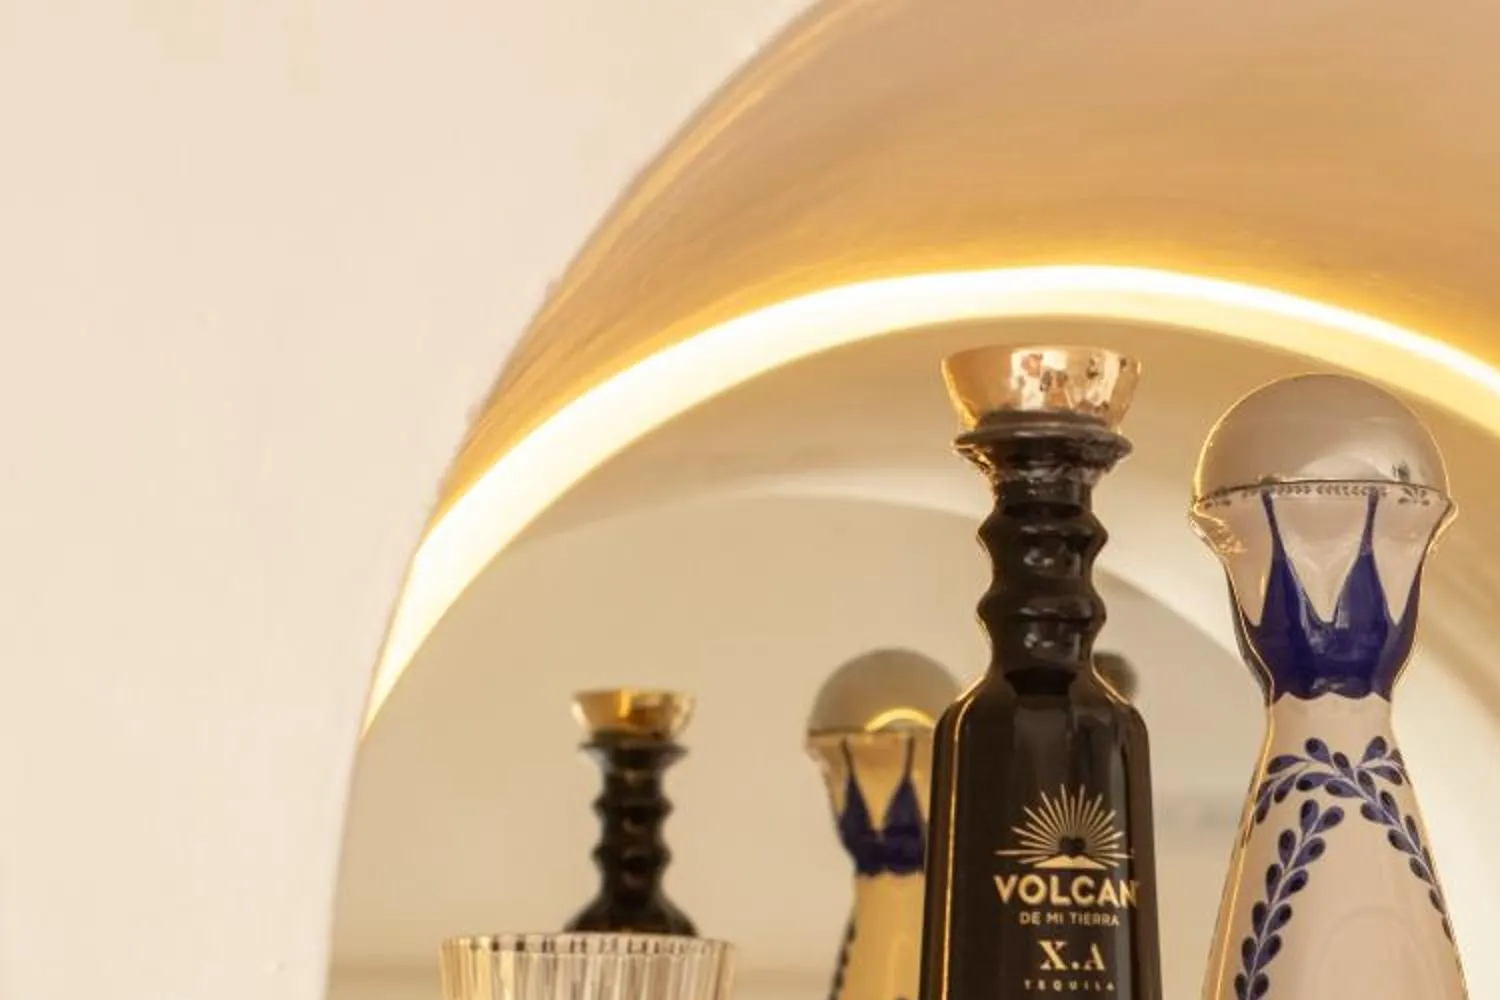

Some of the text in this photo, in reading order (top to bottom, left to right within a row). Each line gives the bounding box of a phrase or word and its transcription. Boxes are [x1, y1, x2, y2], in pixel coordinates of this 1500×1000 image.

[993, 874, 1137, 908] VOLCAN
[1019, 911, 1120, 926] DE MI TIERRA
[1024, 978, 1115, 992] TEQUILA
